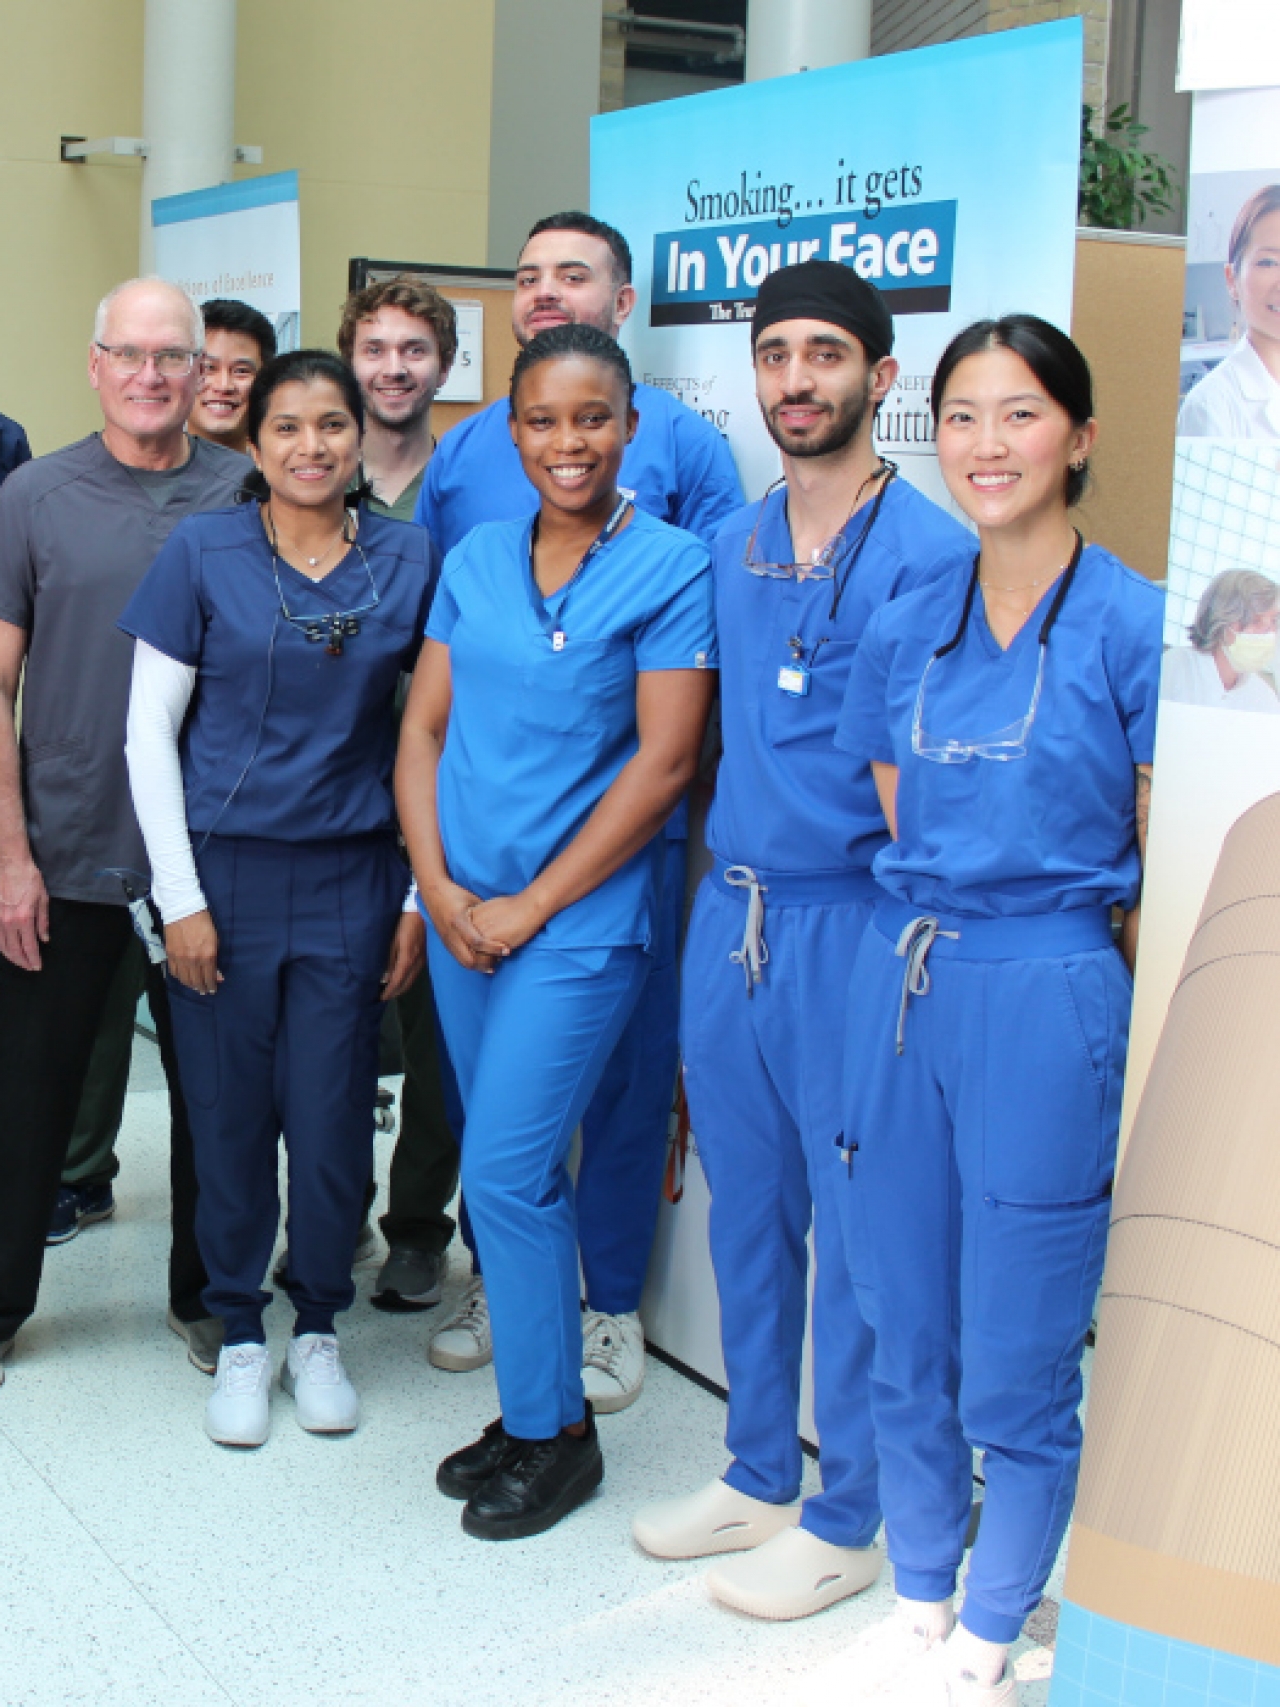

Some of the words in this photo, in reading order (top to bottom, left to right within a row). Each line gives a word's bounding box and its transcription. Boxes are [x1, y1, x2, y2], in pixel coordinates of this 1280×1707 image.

[684, 171, 823, 229] Smoking...
[835, 158, 858, 206] it
[863, 163, 923, 220] gets
[667, 240, 706, 293] In
[829, 221, 939, 278] Face
[709, 302, 732, 320] The
[461, 350, 472, 369] 5
